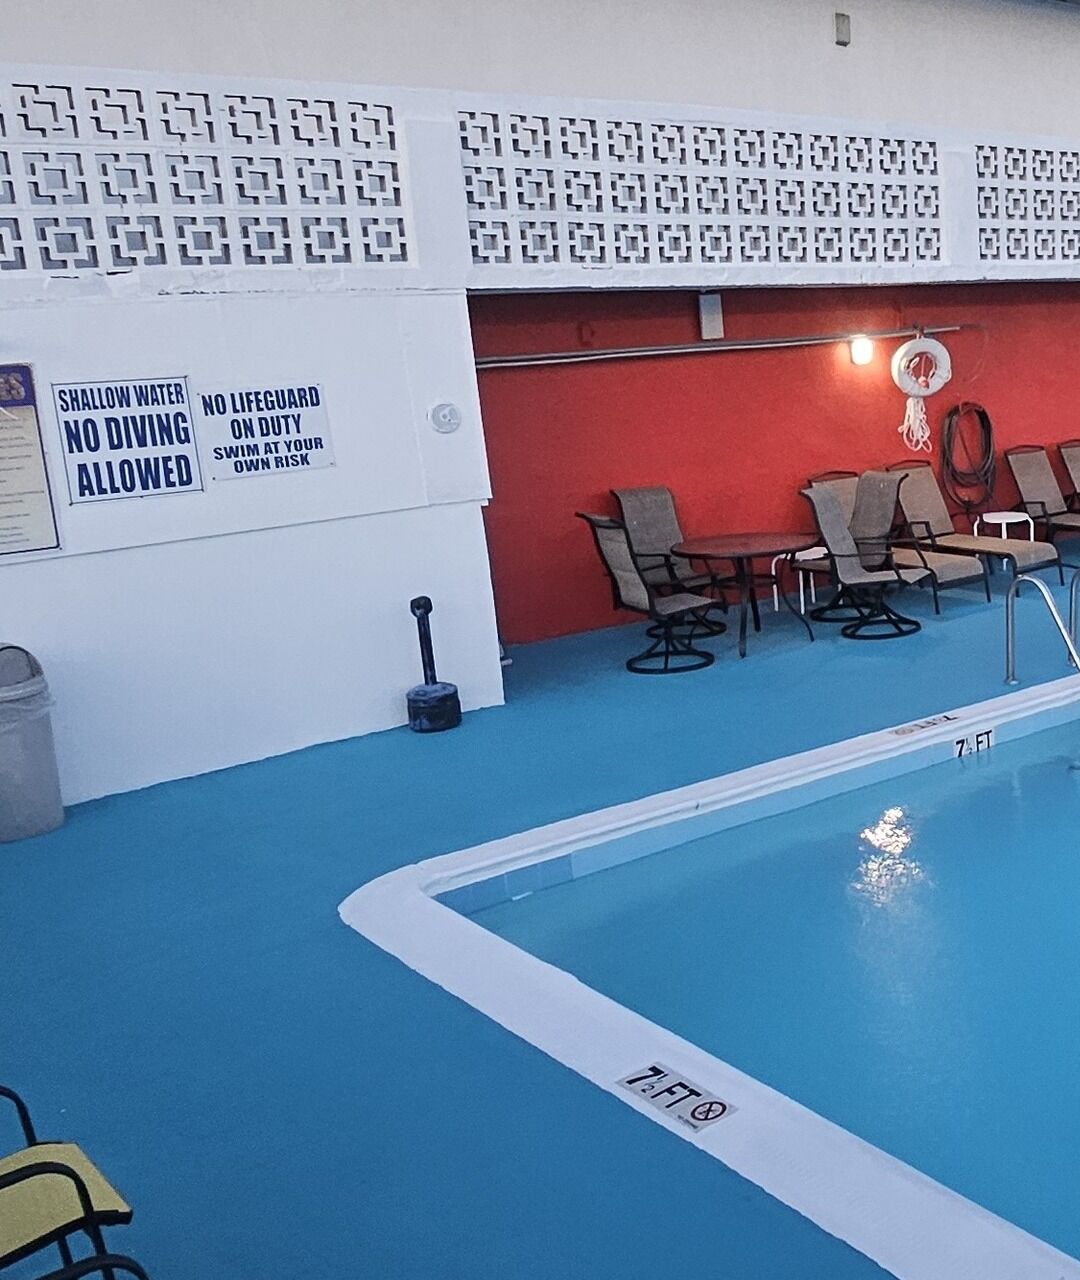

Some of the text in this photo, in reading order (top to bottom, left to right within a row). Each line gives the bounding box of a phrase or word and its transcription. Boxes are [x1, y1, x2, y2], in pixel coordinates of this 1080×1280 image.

[58, 382, 185, 412] SHALLOW WATER
[201, 385, 321, 417] NO LIFEGUARD
[64, 411, 191, 454] NO DIVING
[230, 413, 302, 440] ON DUTY
[213, 437, 324, 461] SWIM AT YOUR
[77, 454, 193, 498] ALLOWED
[233, 453, 311, 474] OWN RISK
[976, 730, 992, 753] FT
[651, 1081, 702, 1109] FT
